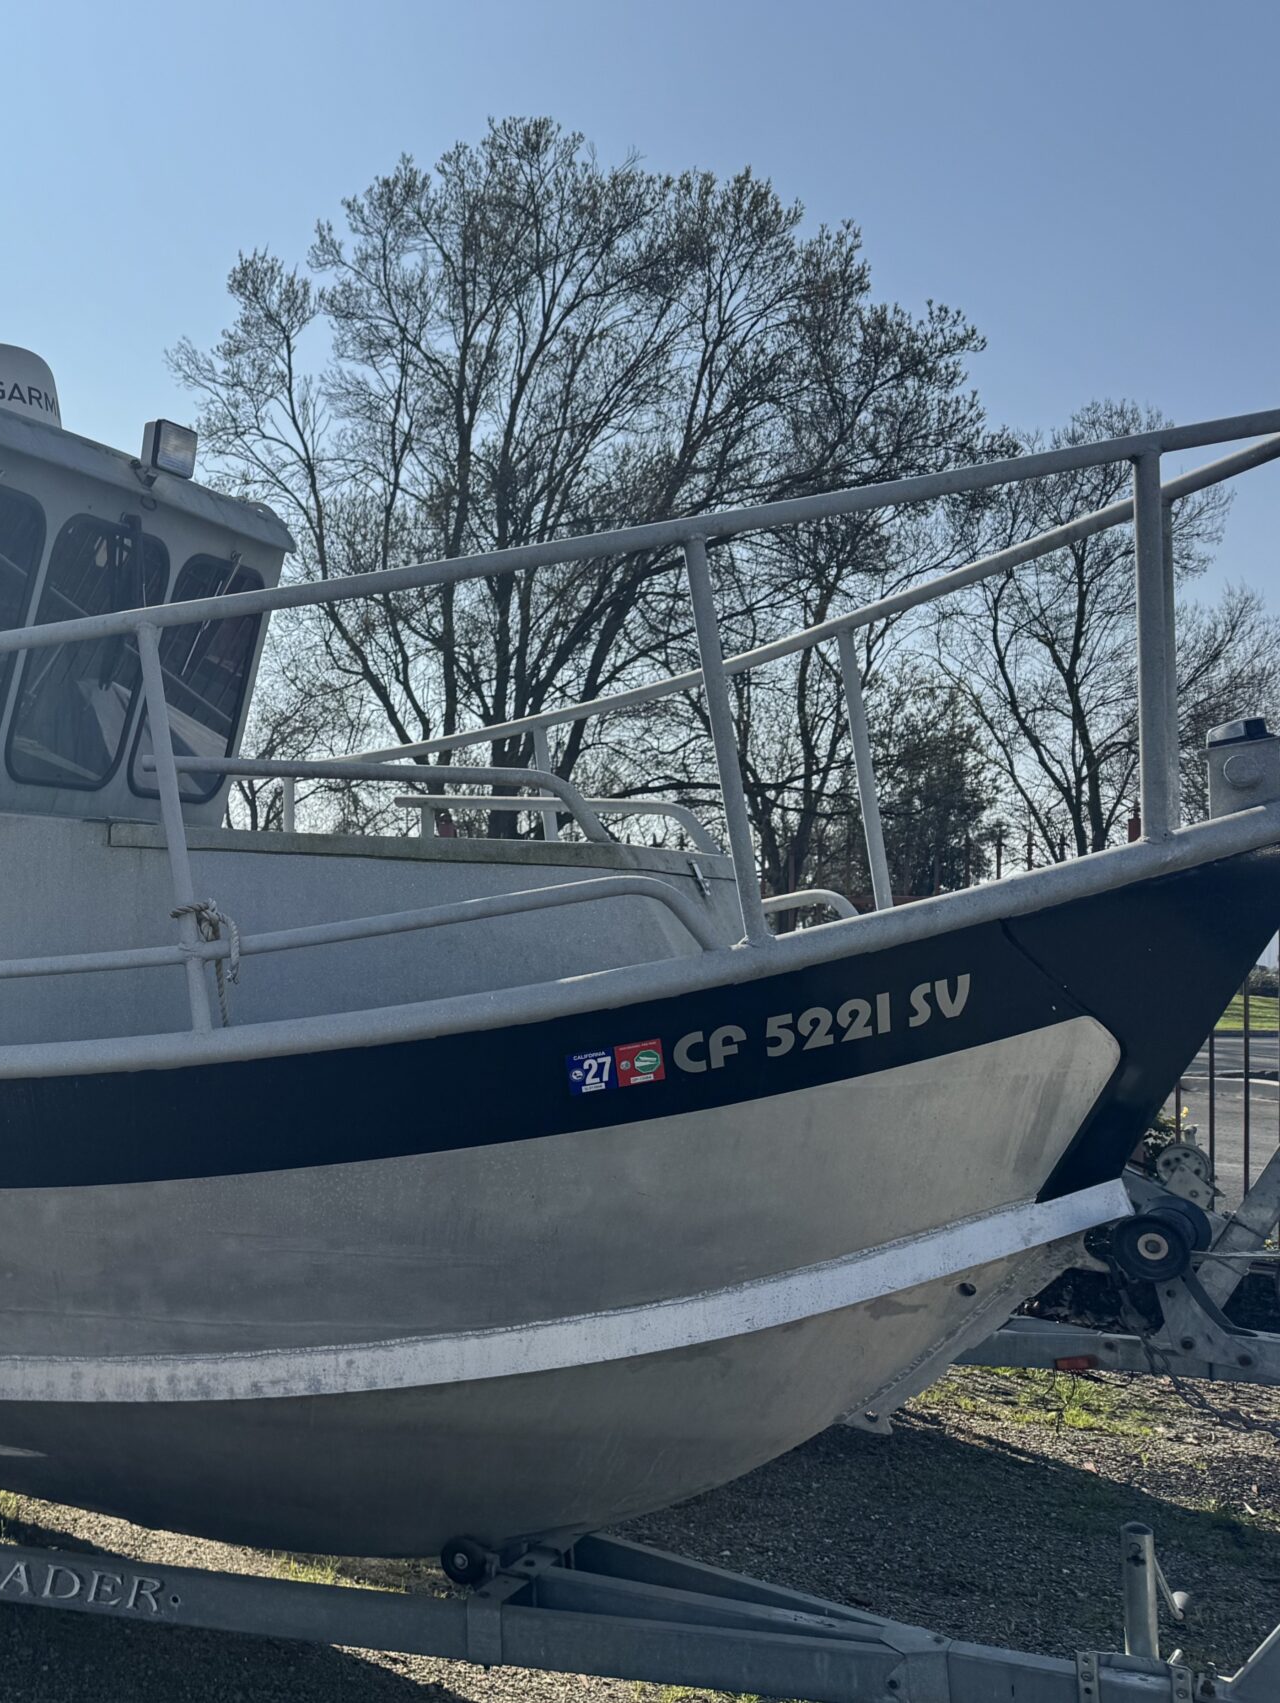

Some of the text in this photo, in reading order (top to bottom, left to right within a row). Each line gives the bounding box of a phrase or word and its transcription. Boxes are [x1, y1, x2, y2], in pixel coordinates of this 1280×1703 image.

[673, 973, 971, 1073] CF 5221 SV
[573, 1051, 606, 1061] CALIFORNIA
[583, 1056, 612, 1085] 27
